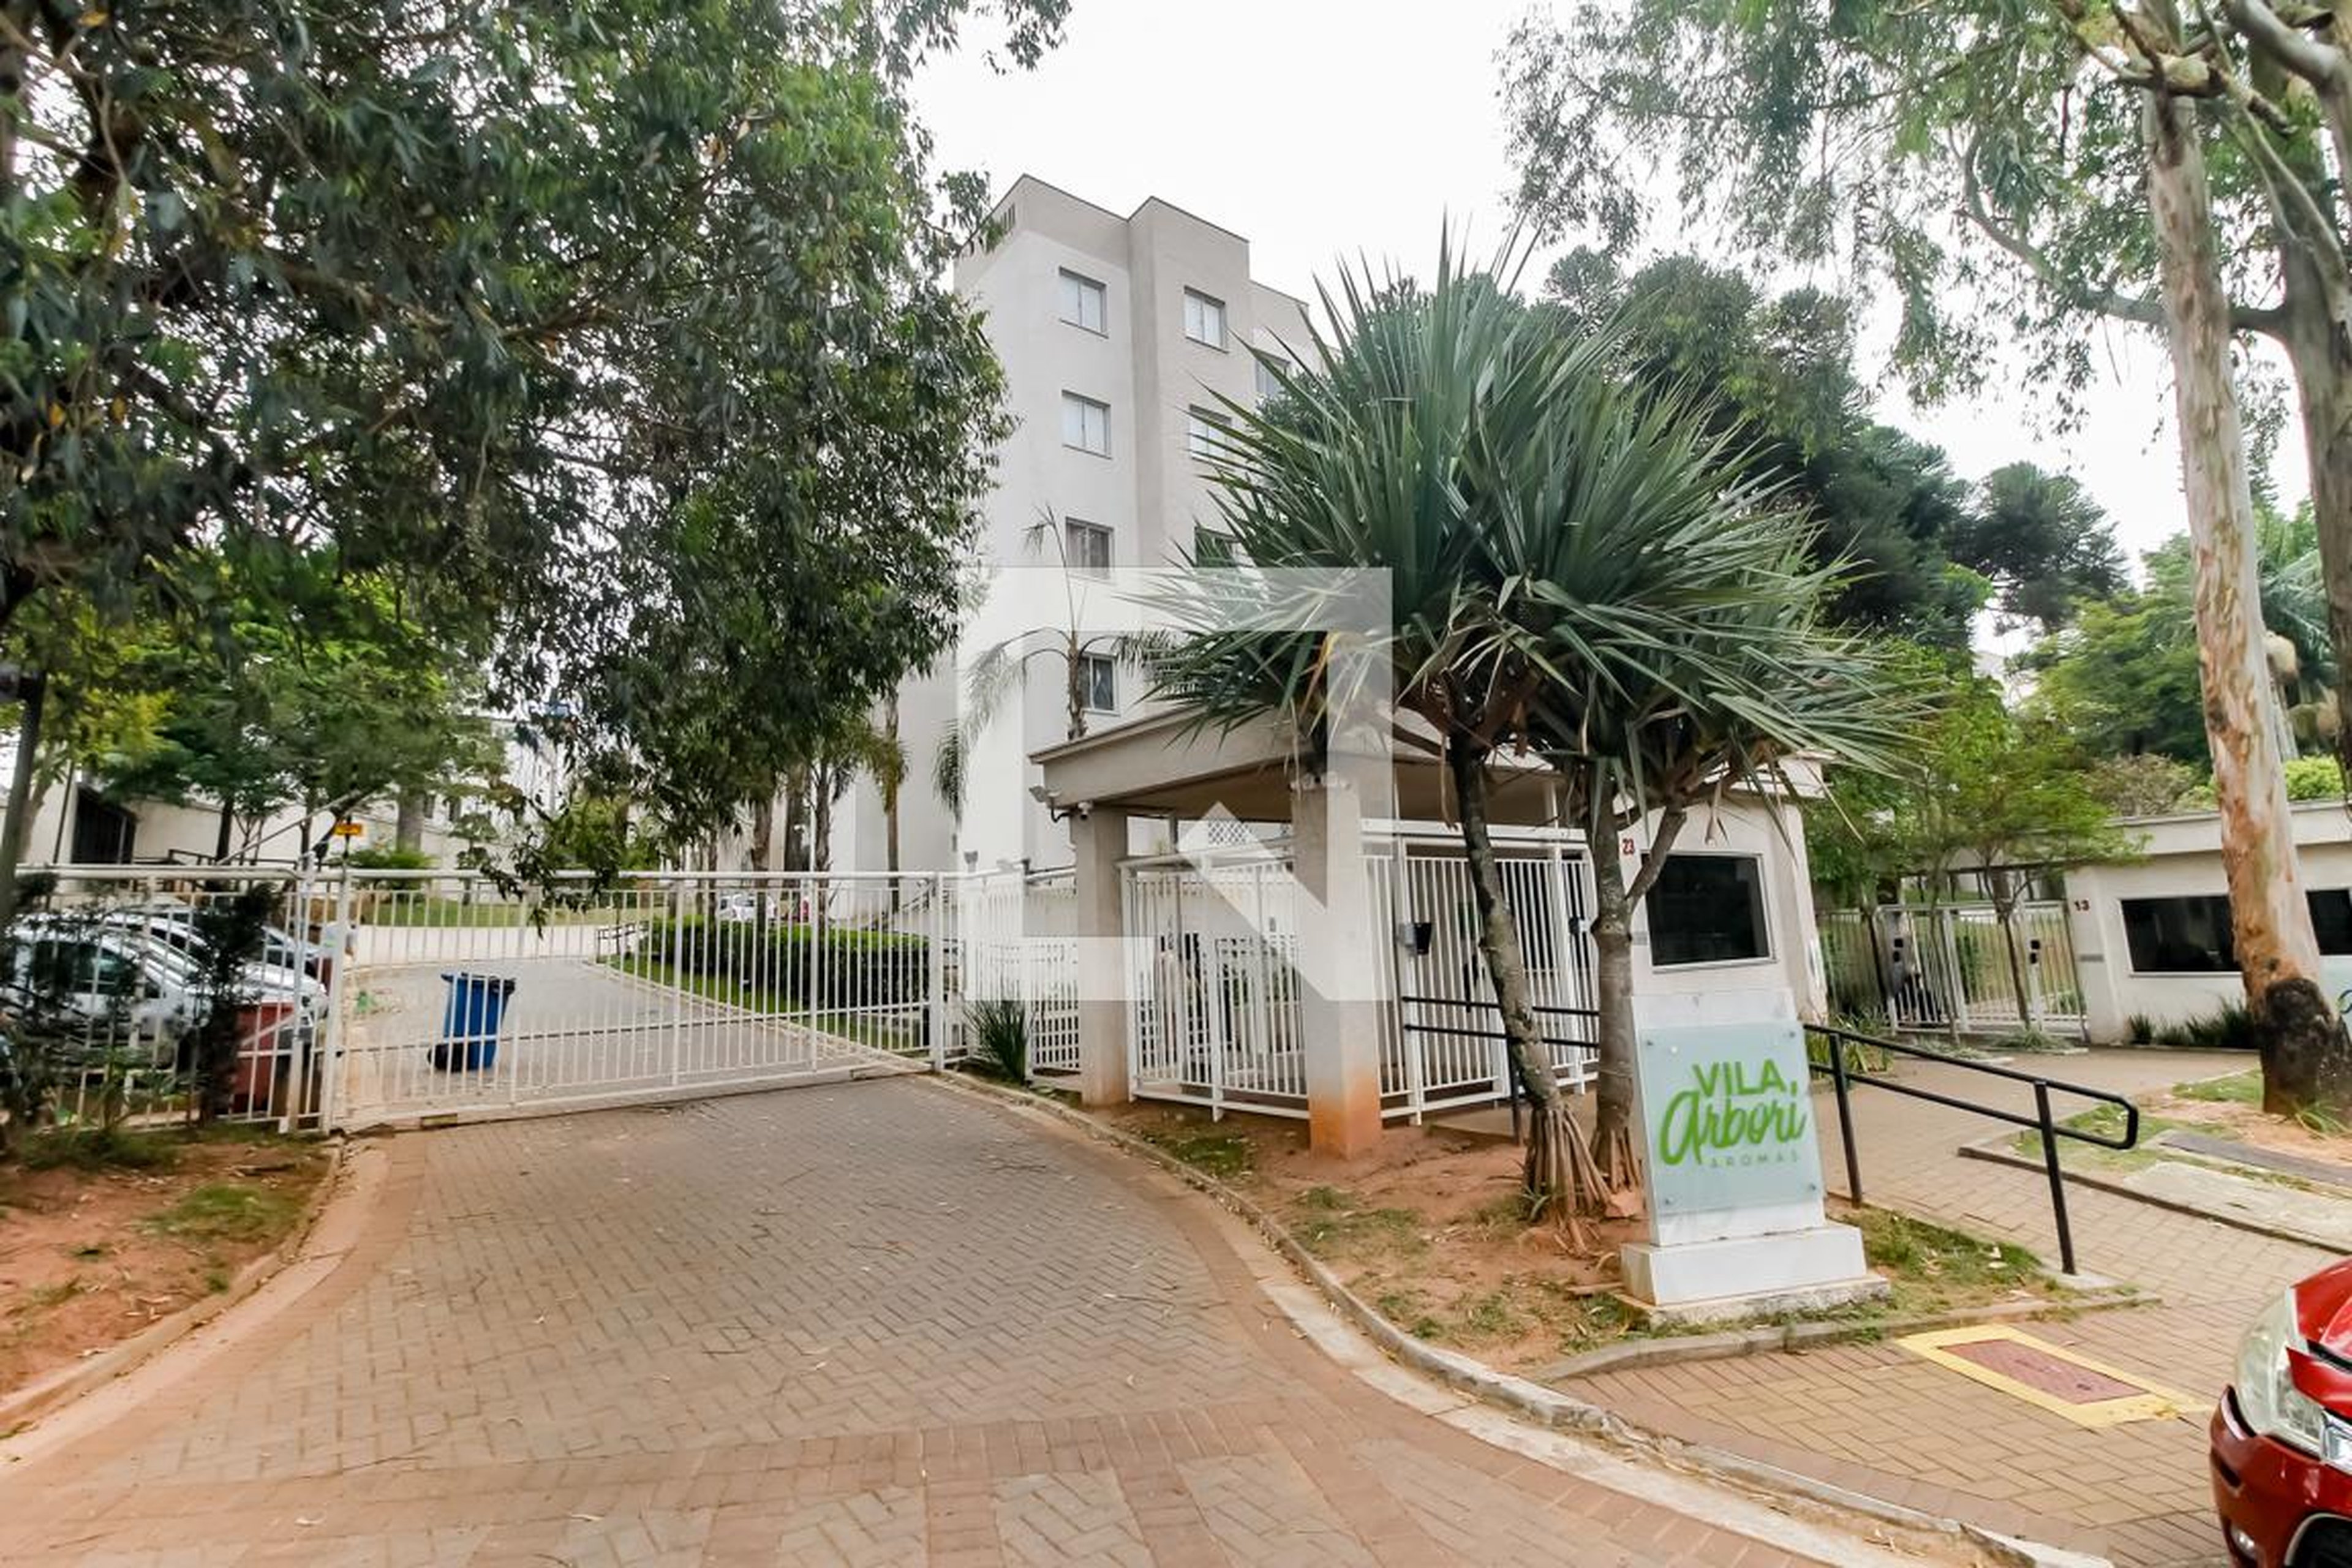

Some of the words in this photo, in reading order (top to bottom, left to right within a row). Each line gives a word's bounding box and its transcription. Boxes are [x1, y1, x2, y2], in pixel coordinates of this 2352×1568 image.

[1623, 838, 1635, 855] 23
[2073, 900, 2089, 911] 13
[1692, 1058, 1787, 1098] VILA
[1660, 1080, 1807, 1166] Arbori
[1711, 1148, 1798, 1169] AROMAS
